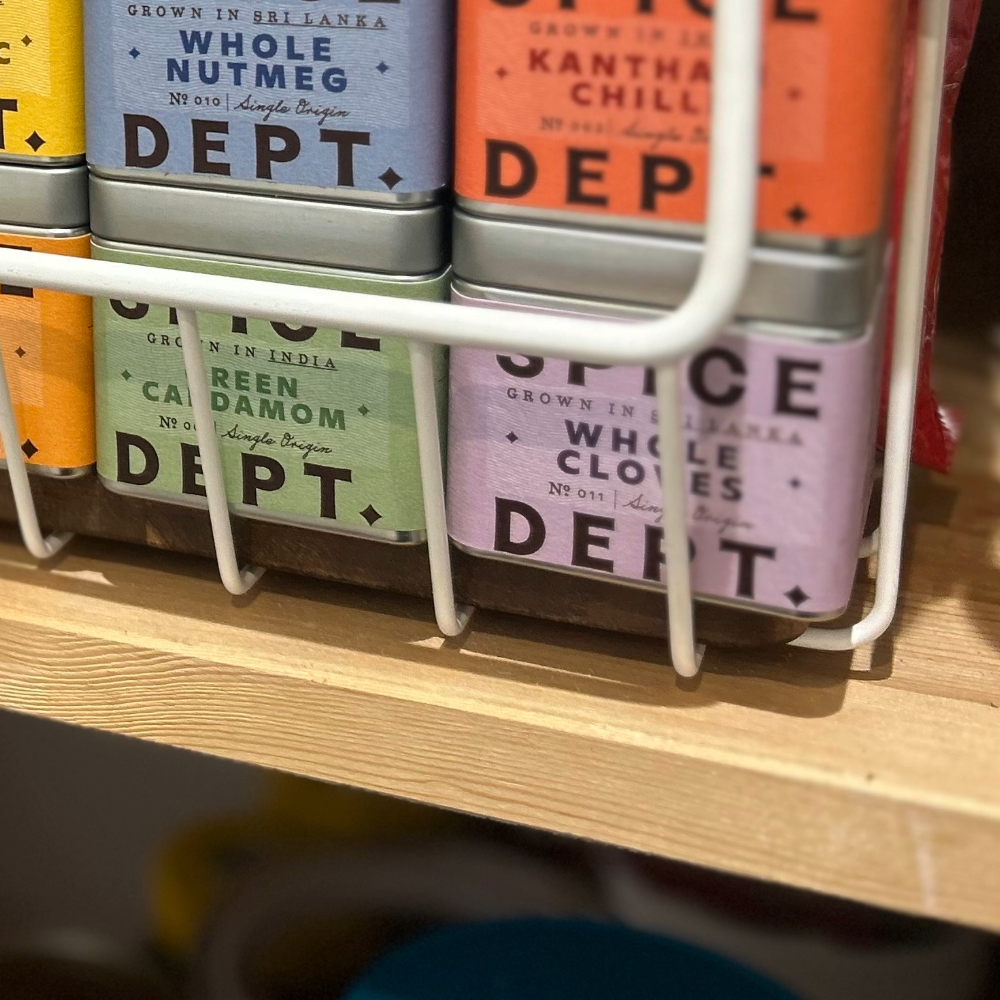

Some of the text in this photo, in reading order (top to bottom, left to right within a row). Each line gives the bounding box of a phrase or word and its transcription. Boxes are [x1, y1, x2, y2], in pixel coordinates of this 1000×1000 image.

[127, 4, 388, 30] GROWN IN SRI LANKA
[529, 21, 620, 39] GROWN
[179, 29, 332, 62] WHOLE
[166, 58, 347, 93] NUTMEG
[194, 96, 221, 107] 010
[234, 95, 290, 122] Single
[295, 98, 349, 125] Origin
[571, 82, 711, 115] CHILL
[147, 332, 338, 371] GRON IN INDIA
[185, 366, 298, 398] REEN
[506, 387, 593, 411] GROWN
[608, 402, 635, 417] IN
[651, 409, 693, 430] SI
[221, 424, 276, 451] Single
[280, 432, 333, 459] Origin
[577, 489, 604, 502] 011
[622, 494, 664, 524] Sing
